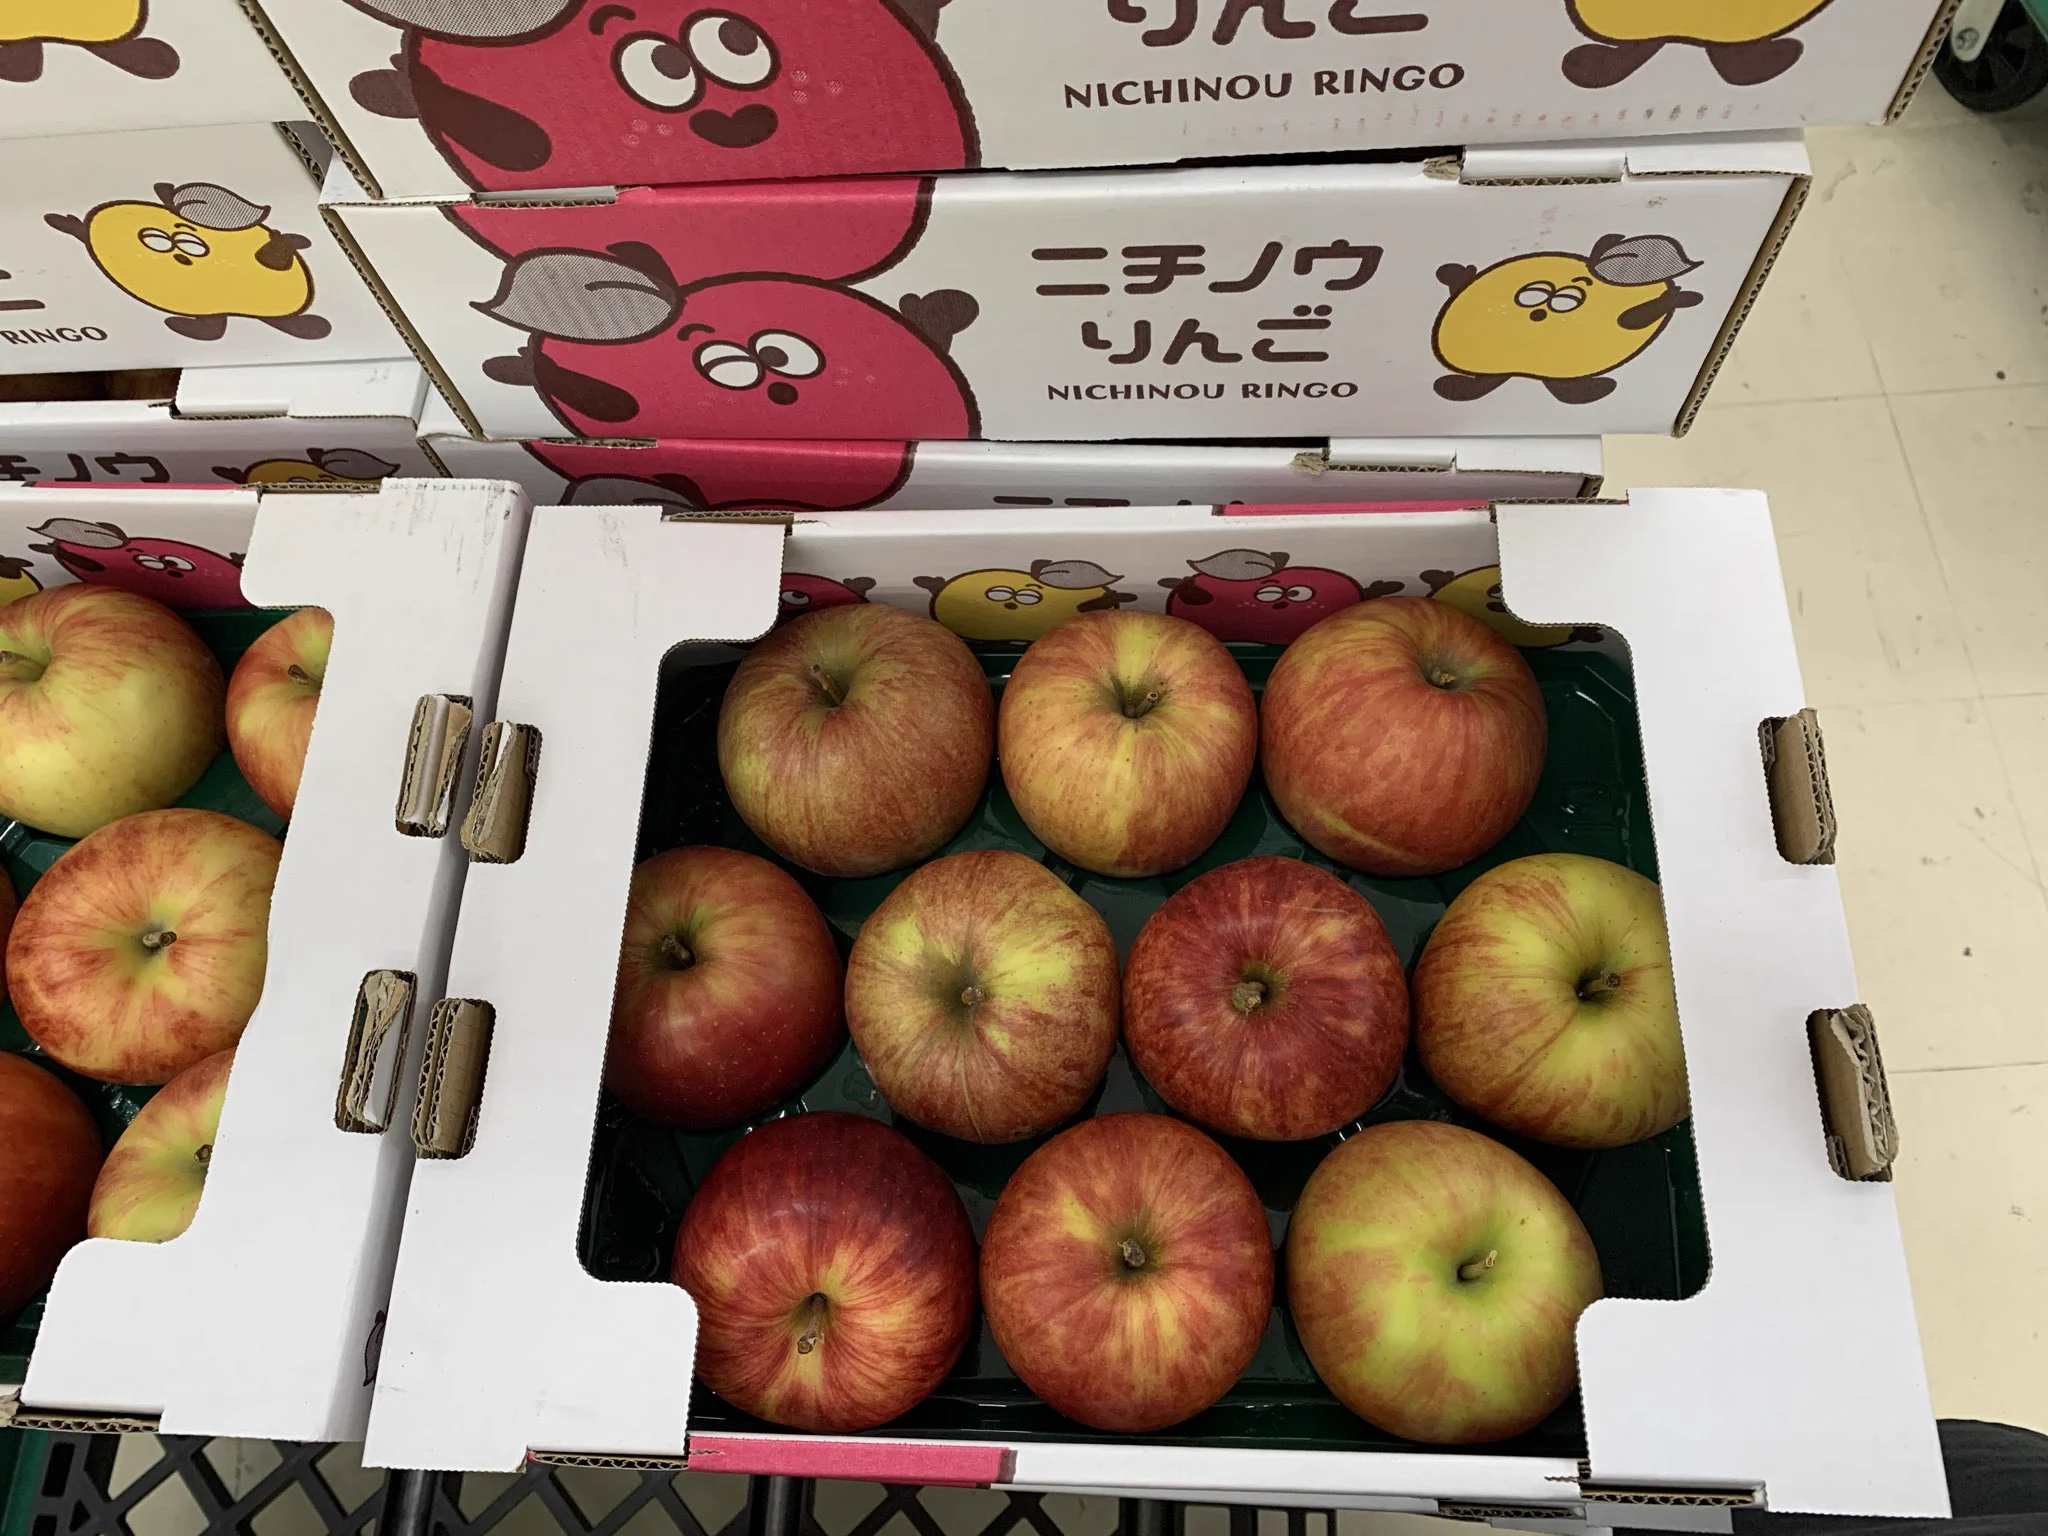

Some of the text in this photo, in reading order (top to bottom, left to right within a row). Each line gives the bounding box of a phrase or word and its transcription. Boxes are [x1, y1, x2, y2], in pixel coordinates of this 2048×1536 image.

[1064, 62, 1466, 109] NICHINOU RINGO
[1031, 239, 1385, 297] ニチノウ
[0, 326, 109, 345] RINGO
[1080, 304, 1334, 366] りんご
[1047, 382, 1359, 401] NICHINOU RINGO
